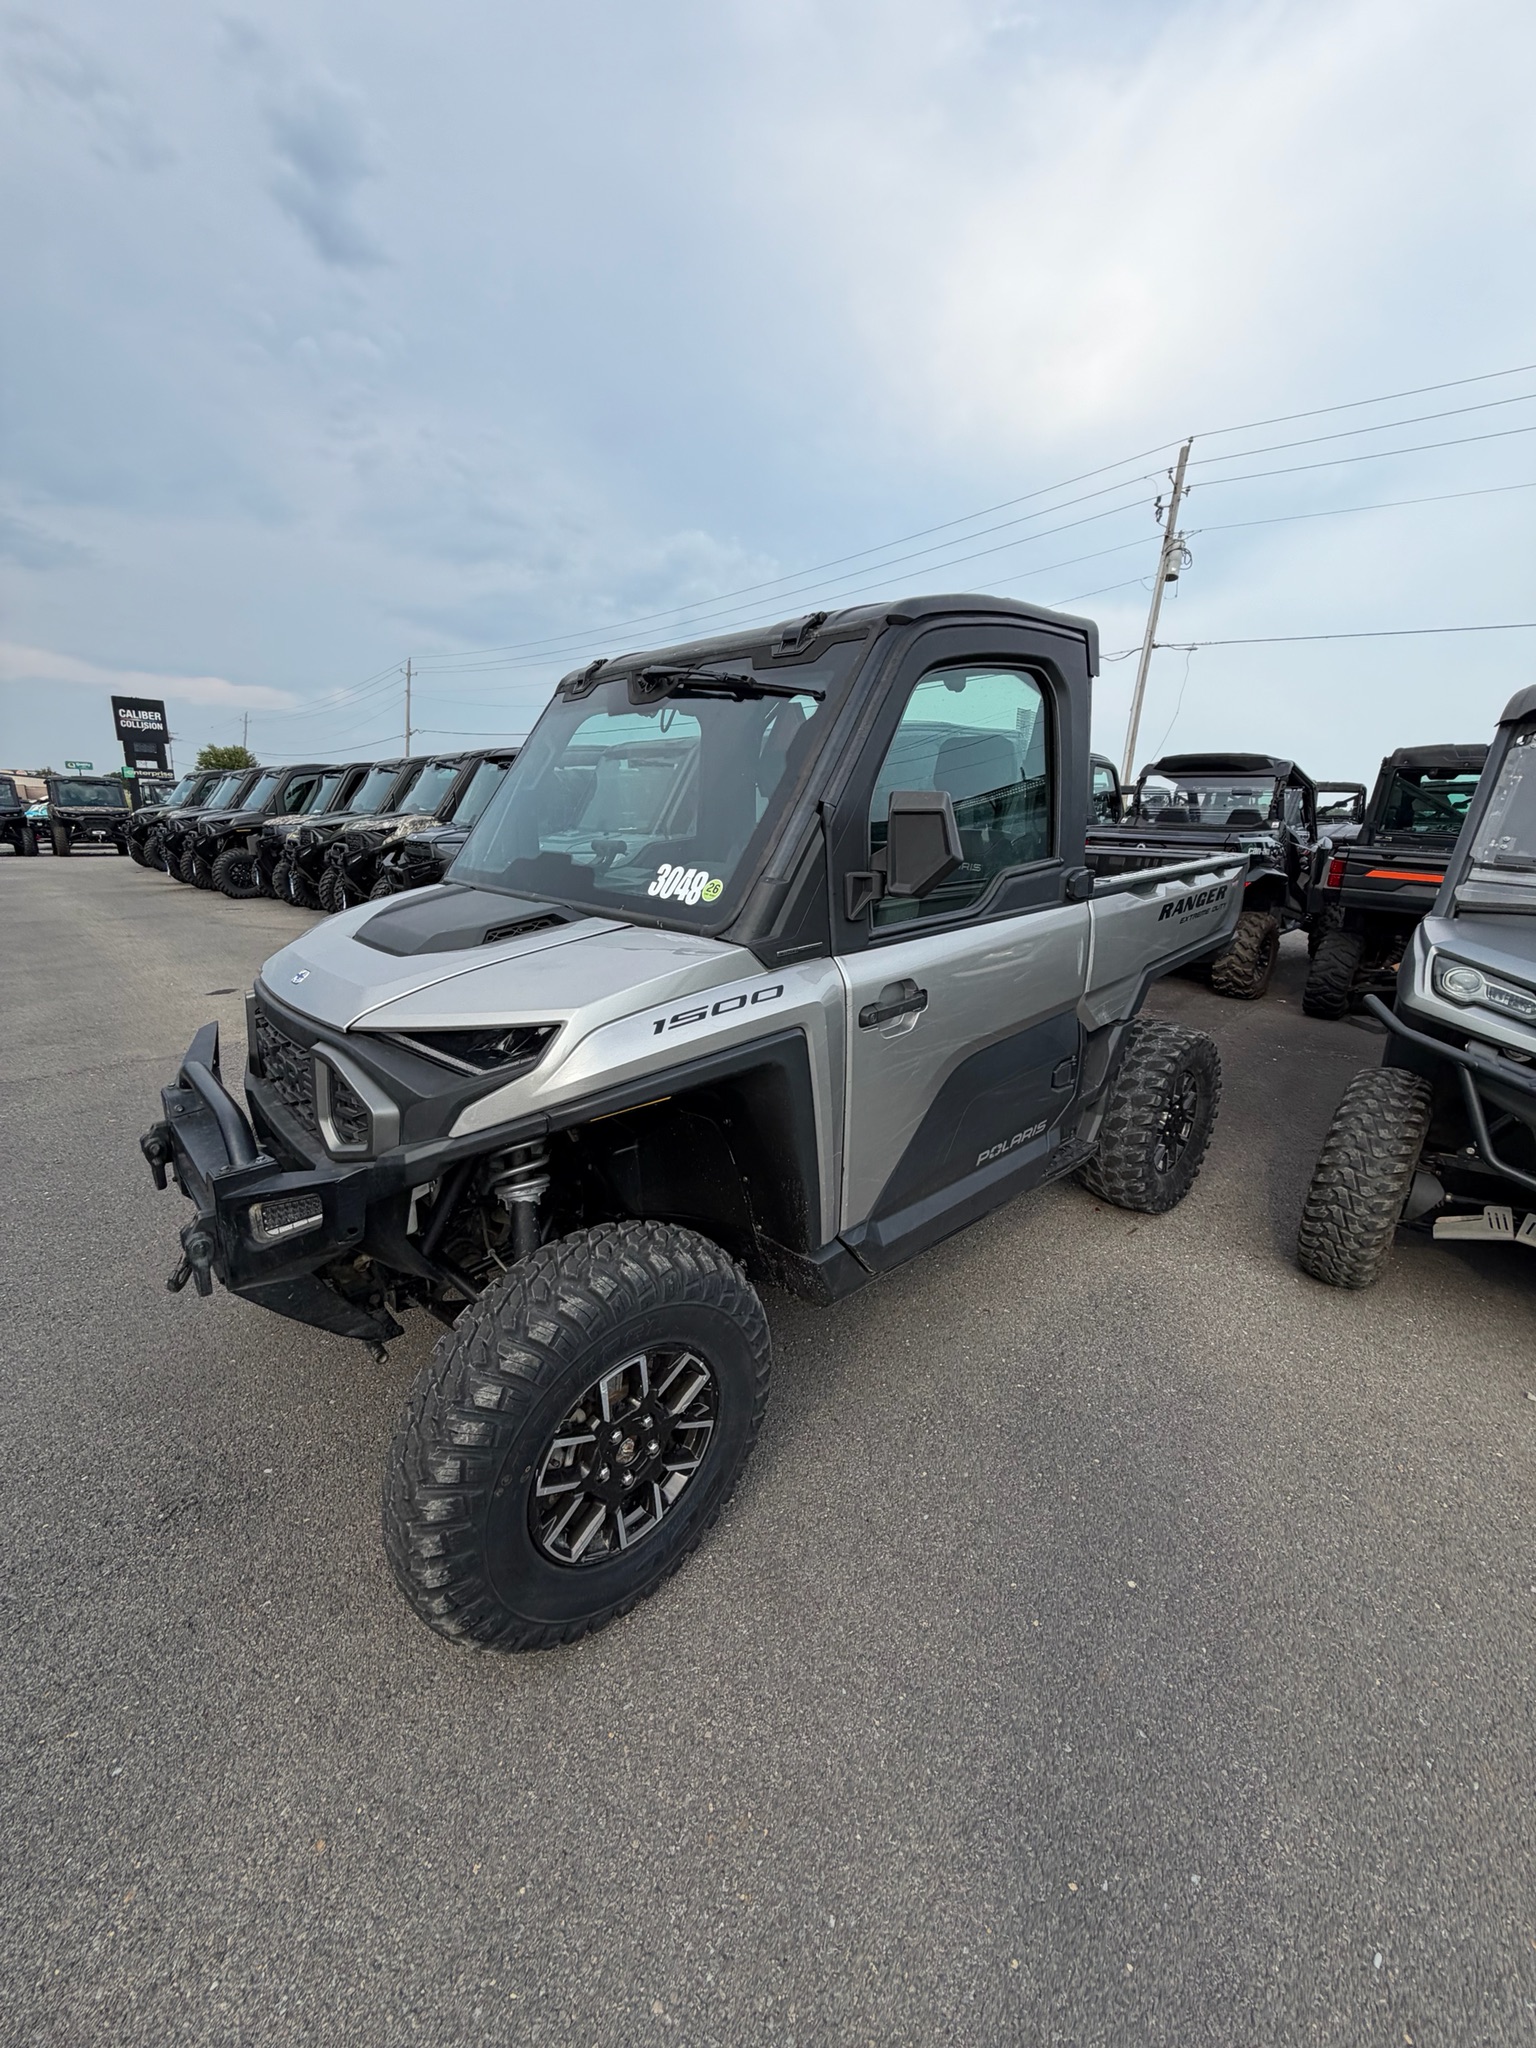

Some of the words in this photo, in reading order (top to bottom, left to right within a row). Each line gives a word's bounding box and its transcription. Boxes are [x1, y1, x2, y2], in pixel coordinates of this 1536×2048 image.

[118, 708, 162, 721] CALIBER
[120, 719, 163, 731] COLLISION
[647, 863, 710, 906] 3048
[706, 882, 721, 894] 26
[1157, 884, 1228, 922] RANGER
[1179, 908, 1211, 925] EXTREME
[1211, 902, 1227, 914] DUTY
[652, 984, 784, 1036] 1500
[975, 1119, 1048, 1167] POLARIS
